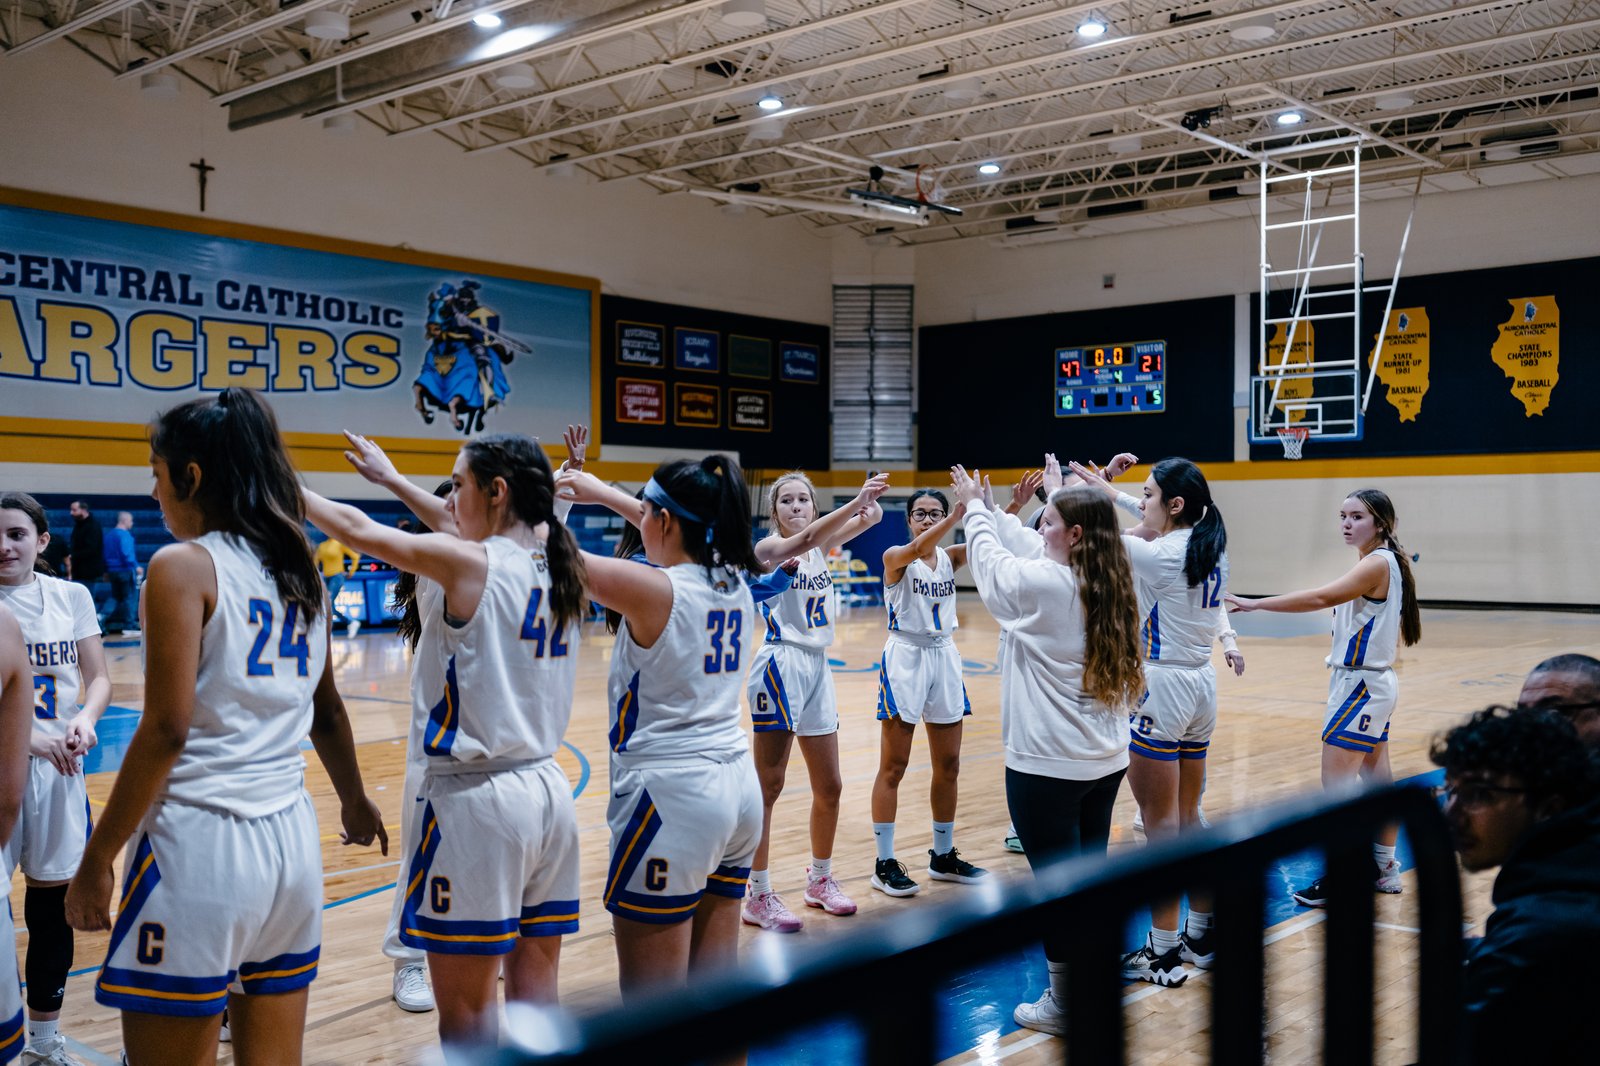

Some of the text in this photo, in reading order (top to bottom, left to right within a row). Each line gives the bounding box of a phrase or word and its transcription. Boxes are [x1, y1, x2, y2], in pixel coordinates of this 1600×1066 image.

[216, 279, 403, 328] CATHOLIC
[1530, 322, 1557, 330] CENTRAL
[1094, 347, 1123, 366] 0.0
[1136, 343, 1163, 353] VISITOR
[1393, 352, 1412, 360] STATE
[1507, 351, 1552, 360] CHAMPIONS
[1062, 361, 1080, 378] 47
[1142, 355, 1161, 373] 21
[1384, 359, 1422, 367] RUNNER-UP
[1520, 359, 1539, 367] 1983
[1114, 370, 1122, 384] 4
[1517, 379, 1551, 388] BASEBALL
[1153, 390, 1161, 405] 5
[1391, 386, 1421, 395] BASEBALL
[1062, 395, 1073, 410] 10
[1202, 565, 1222, 609] 12
[806, 594, 829, 629] 15
[932, 602, 942, 631] 1
[247, 597, 311, 677] 24
[704, 608, 743, 674] 33
[33, 674, 58, 720] 3
[757, 692, 768, 712] C
[1138, 715, 1154, 735] C
[1358, 714, 1371, 732] C
[645, 857, 668, 892] C
[430, 876, 451, 914] C
[137, 922, 165, 966] C
